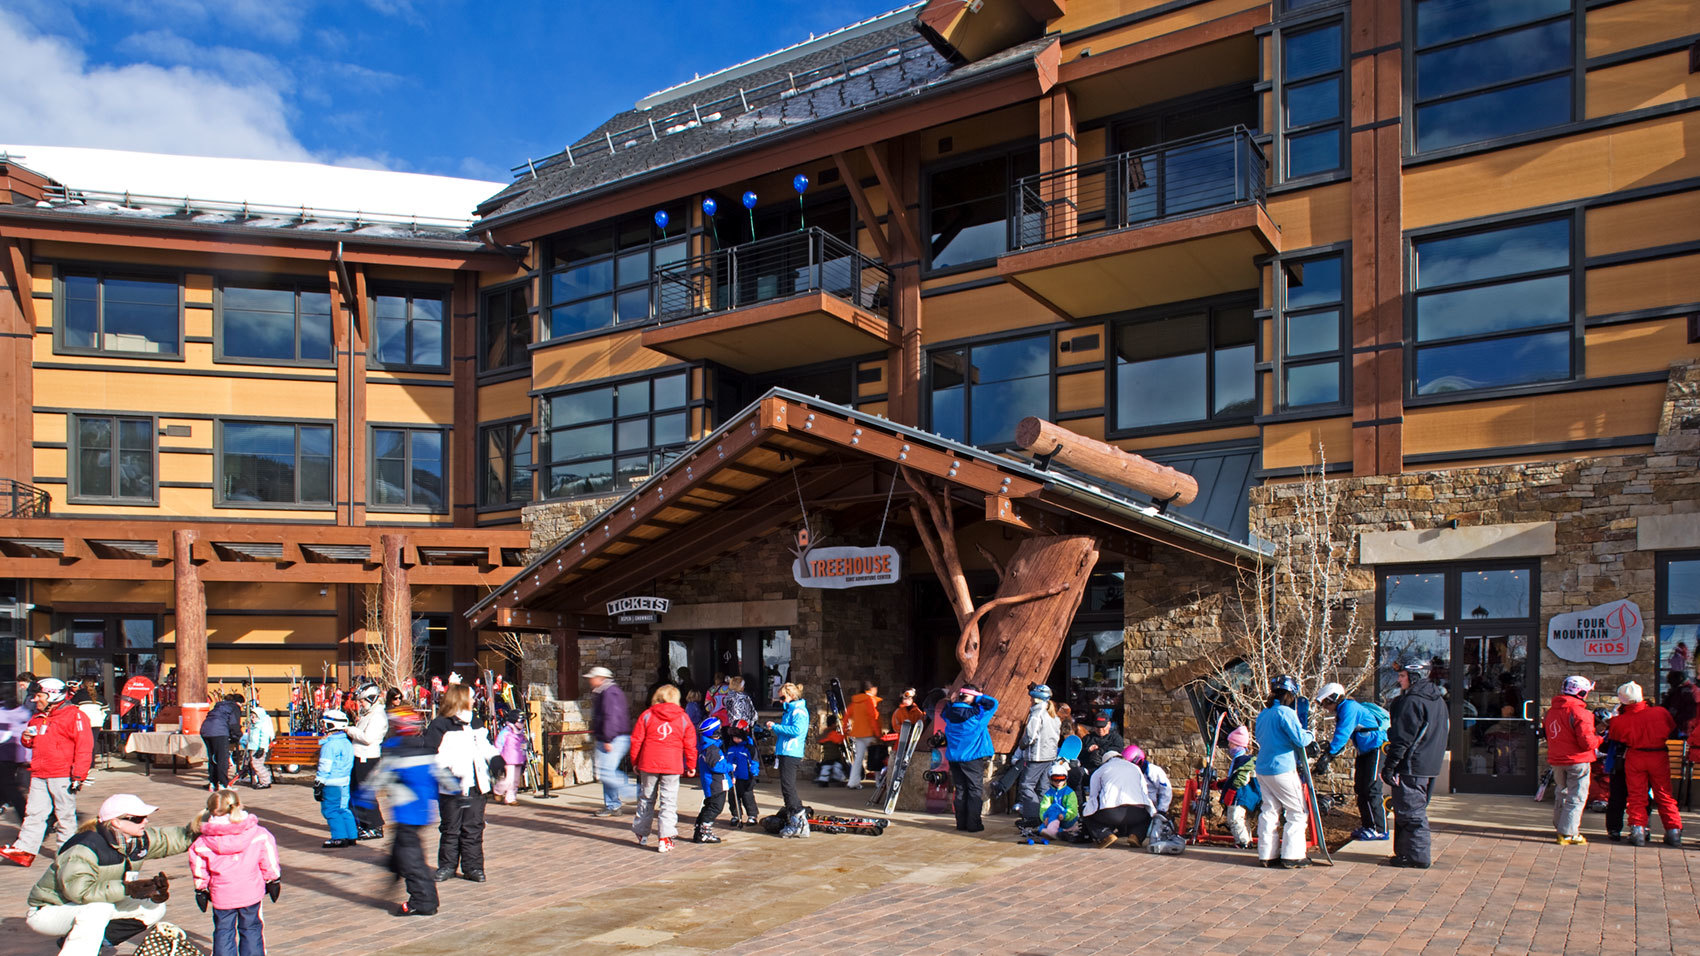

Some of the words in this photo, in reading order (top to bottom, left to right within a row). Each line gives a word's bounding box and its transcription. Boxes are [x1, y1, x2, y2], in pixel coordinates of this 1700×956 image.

[809, 554, 891, 578] TREEHOUSE
[608, 598, 667, 614] TICKETS
[1577, 618, 1605, 628] FOUR
[1553, 628, 1608, 640] MOUNTAIN
